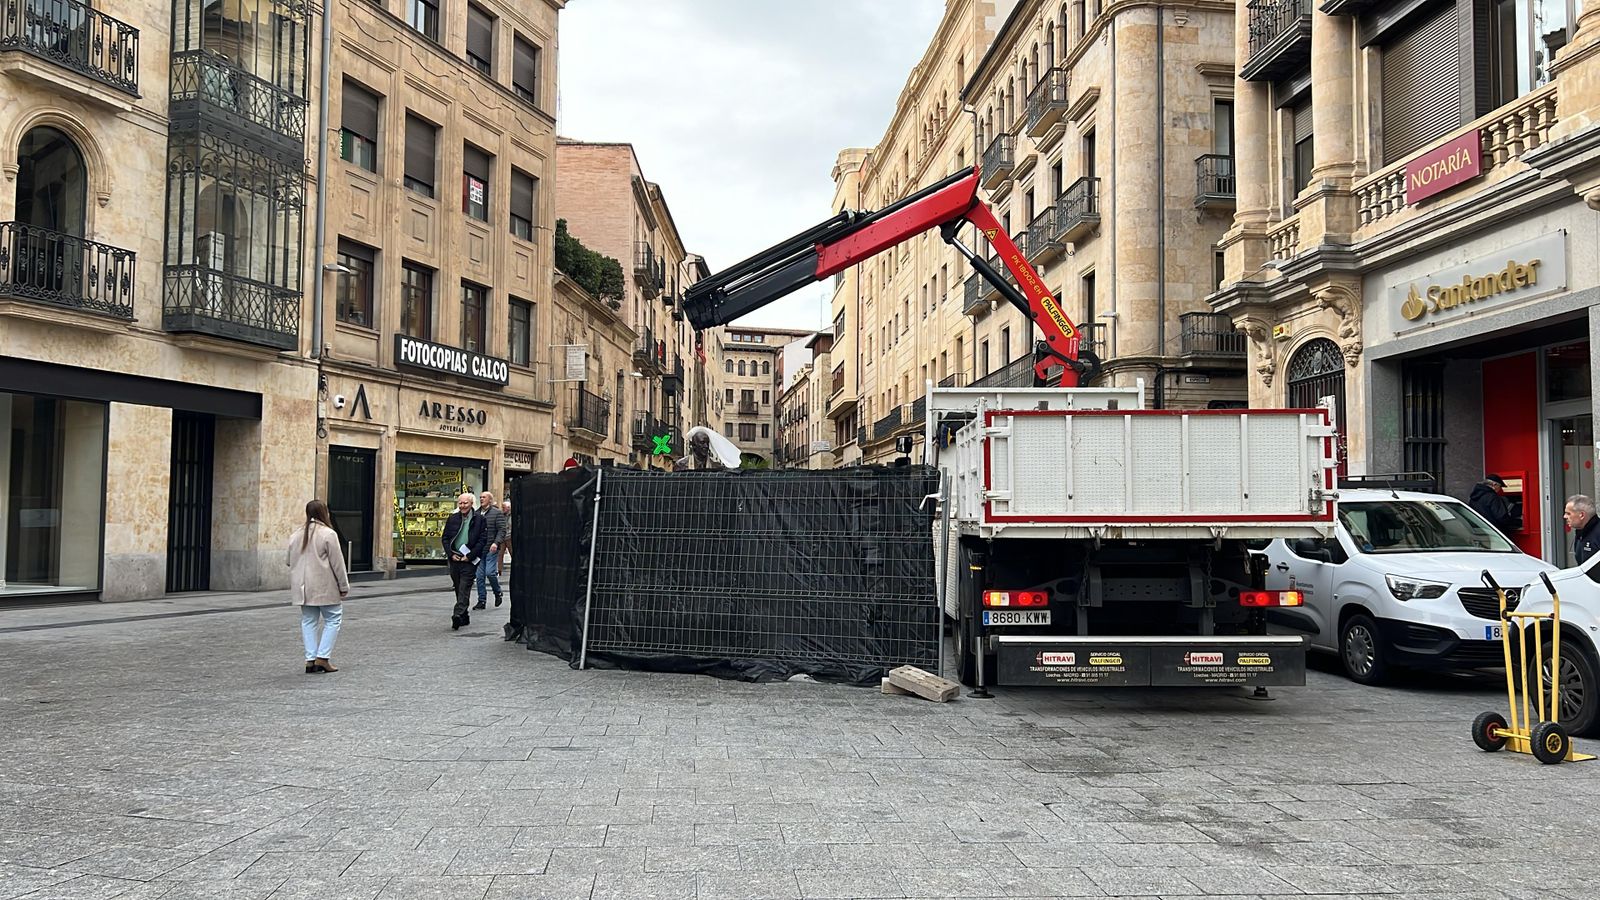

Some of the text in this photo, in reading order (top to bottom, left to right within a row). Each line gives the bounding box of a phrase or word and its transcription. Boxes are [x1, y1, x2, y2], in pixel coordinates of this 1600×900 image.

[1411, 147, 1472, 191] NOTARÍA
[1011, 254, 1019, 266] PK
[1019, 262, 1036, 285] 18002
[1427, 259, 1541, 313] Santander
[1042, 298, 1072, 336] PALFINGER
[401, 338, 508, 382] FOTOCOPIAS CALCO
[418, 400, 487, 426] ARESSO
[439, 424, 465, 433] JOYERÍAS
[514, 452, 531, 465] CALCO
[992, 612, 1048, 624] 8680 KWW
[1044, 655, 1074, 663] HITRAVI
[1192, 655, 1222, 663] HITRAVI
